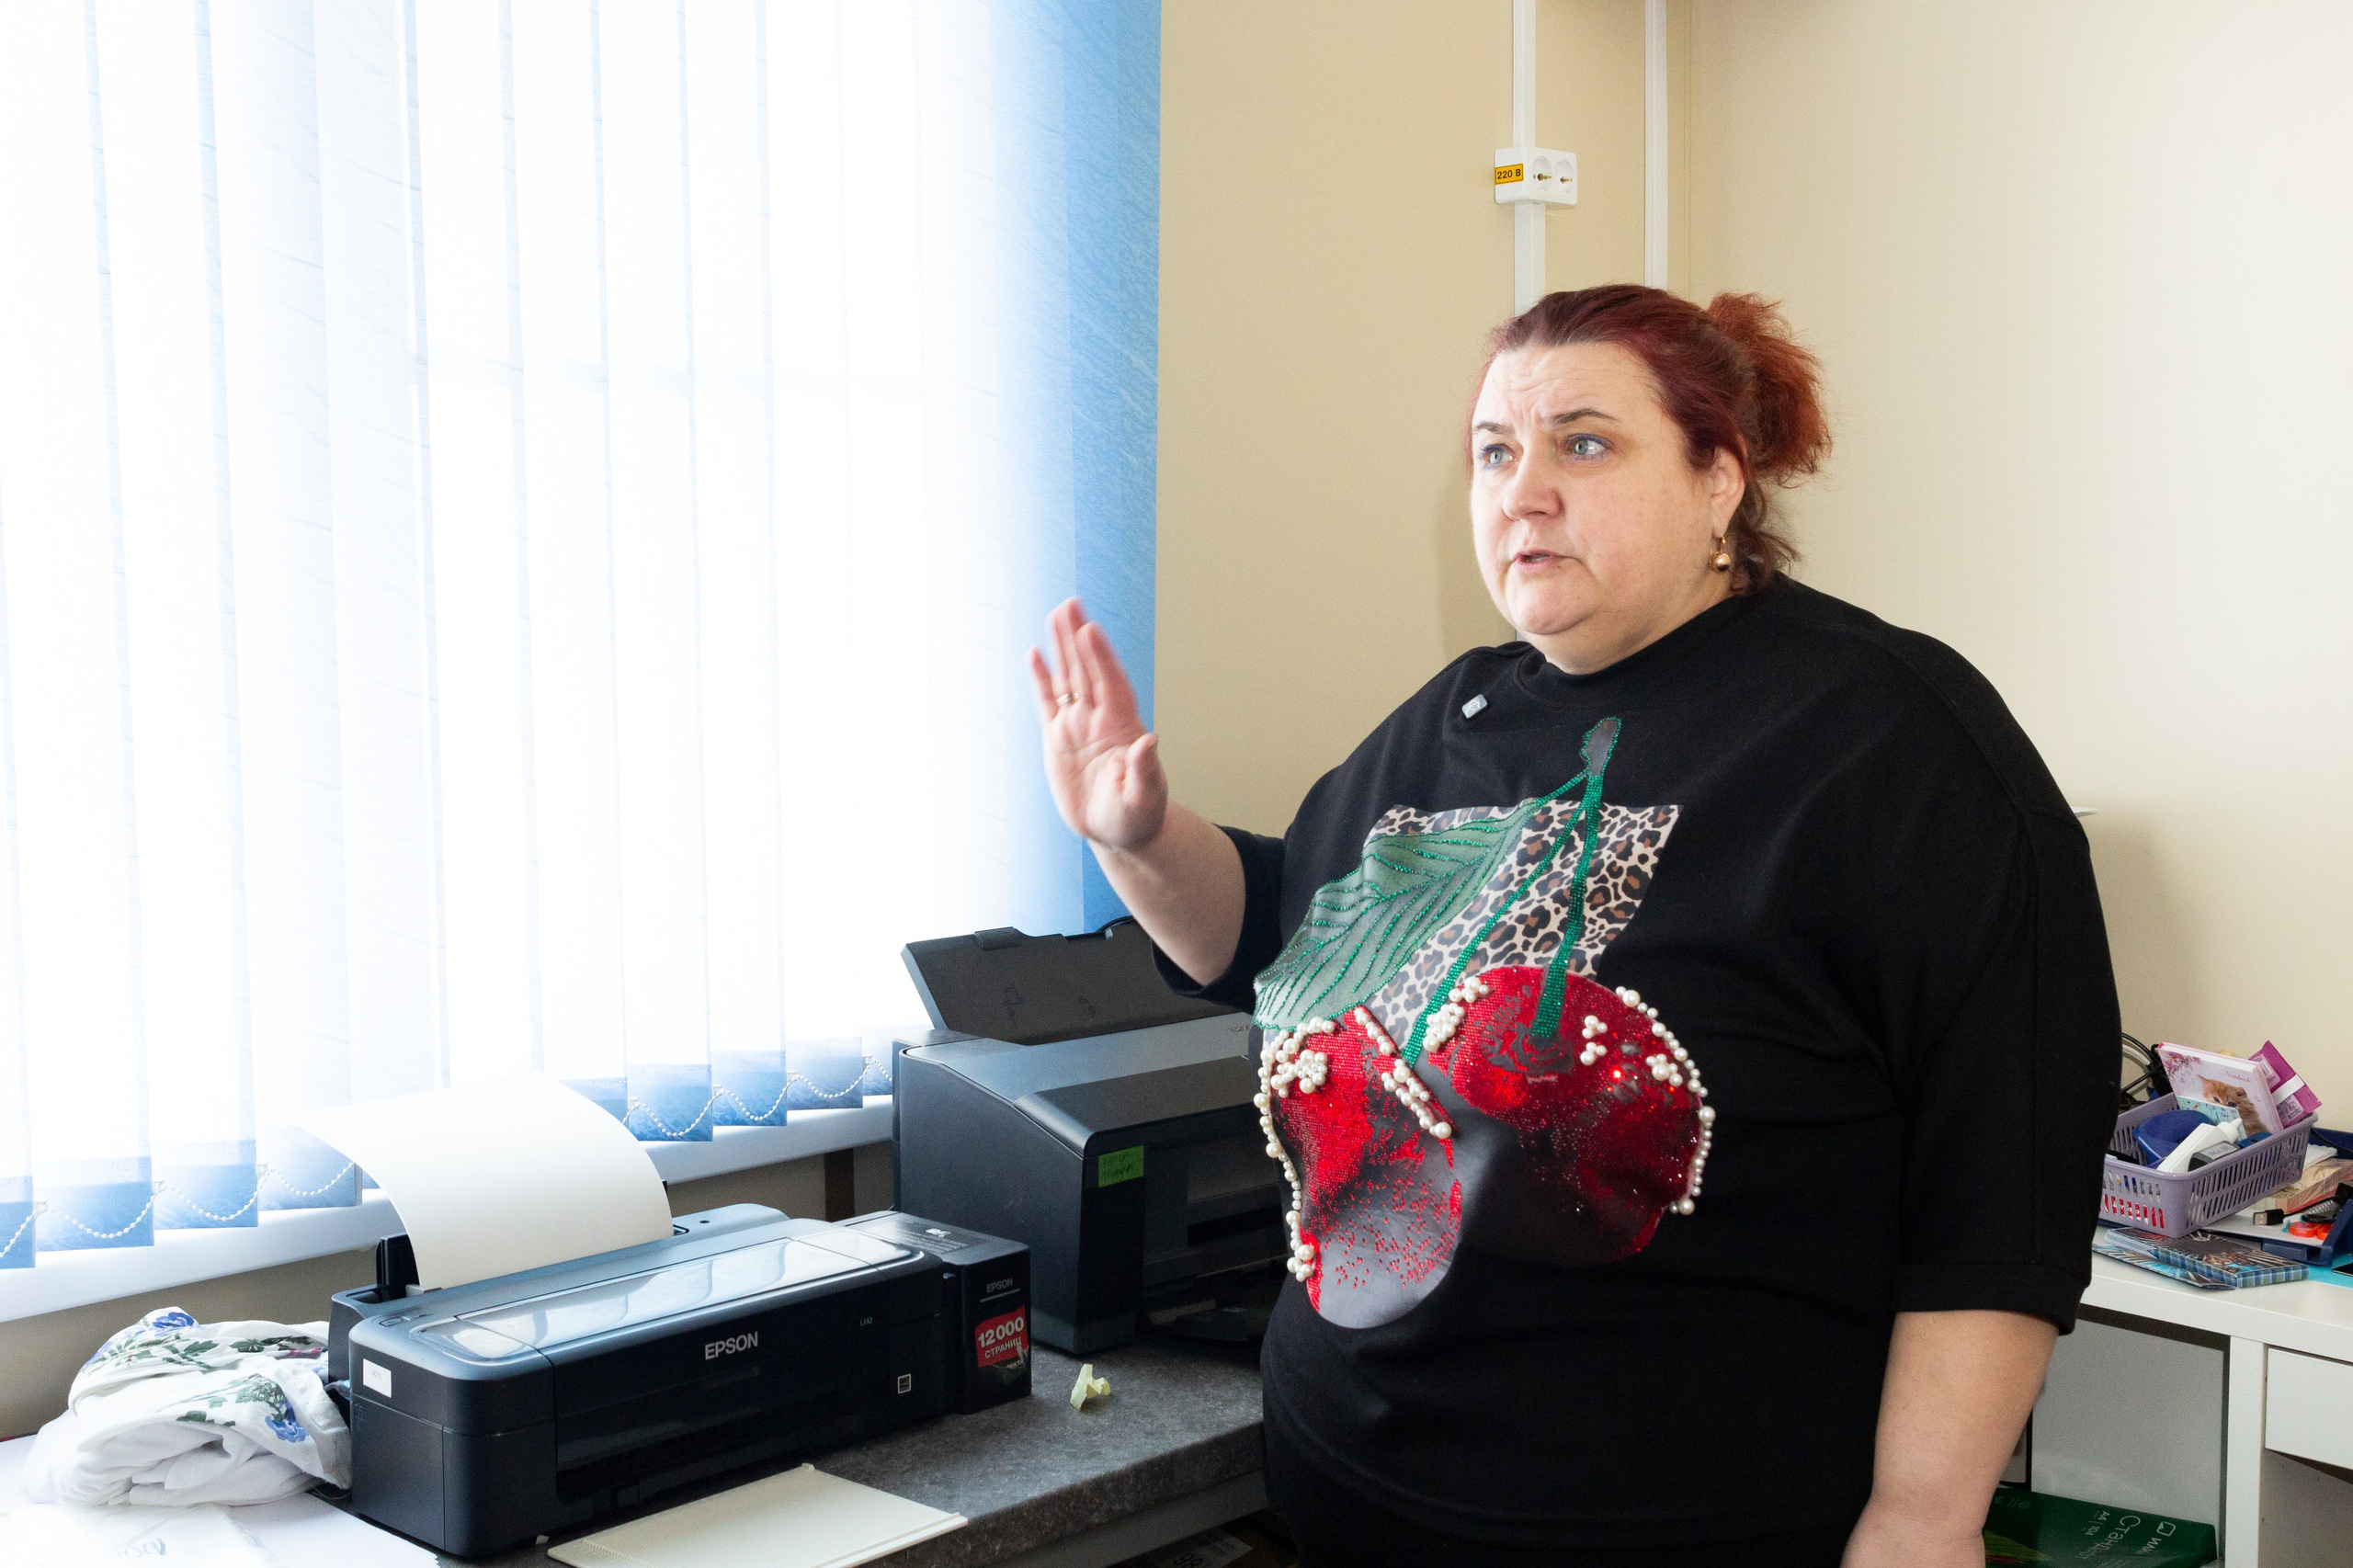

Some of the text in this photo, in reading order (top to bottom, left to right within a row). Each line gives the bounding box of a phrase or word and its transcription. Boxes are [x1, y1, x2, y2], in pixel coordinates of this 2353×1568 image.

[1496, 169, 1513, 179] 220
[986, 1278, 1013, 1293] EPSON
[859, 1316, 873, 1326] L132
[704, 1331, 759, 1360] EPSON
[984, 1336, 1022, 1358] СТРАНИЦ
